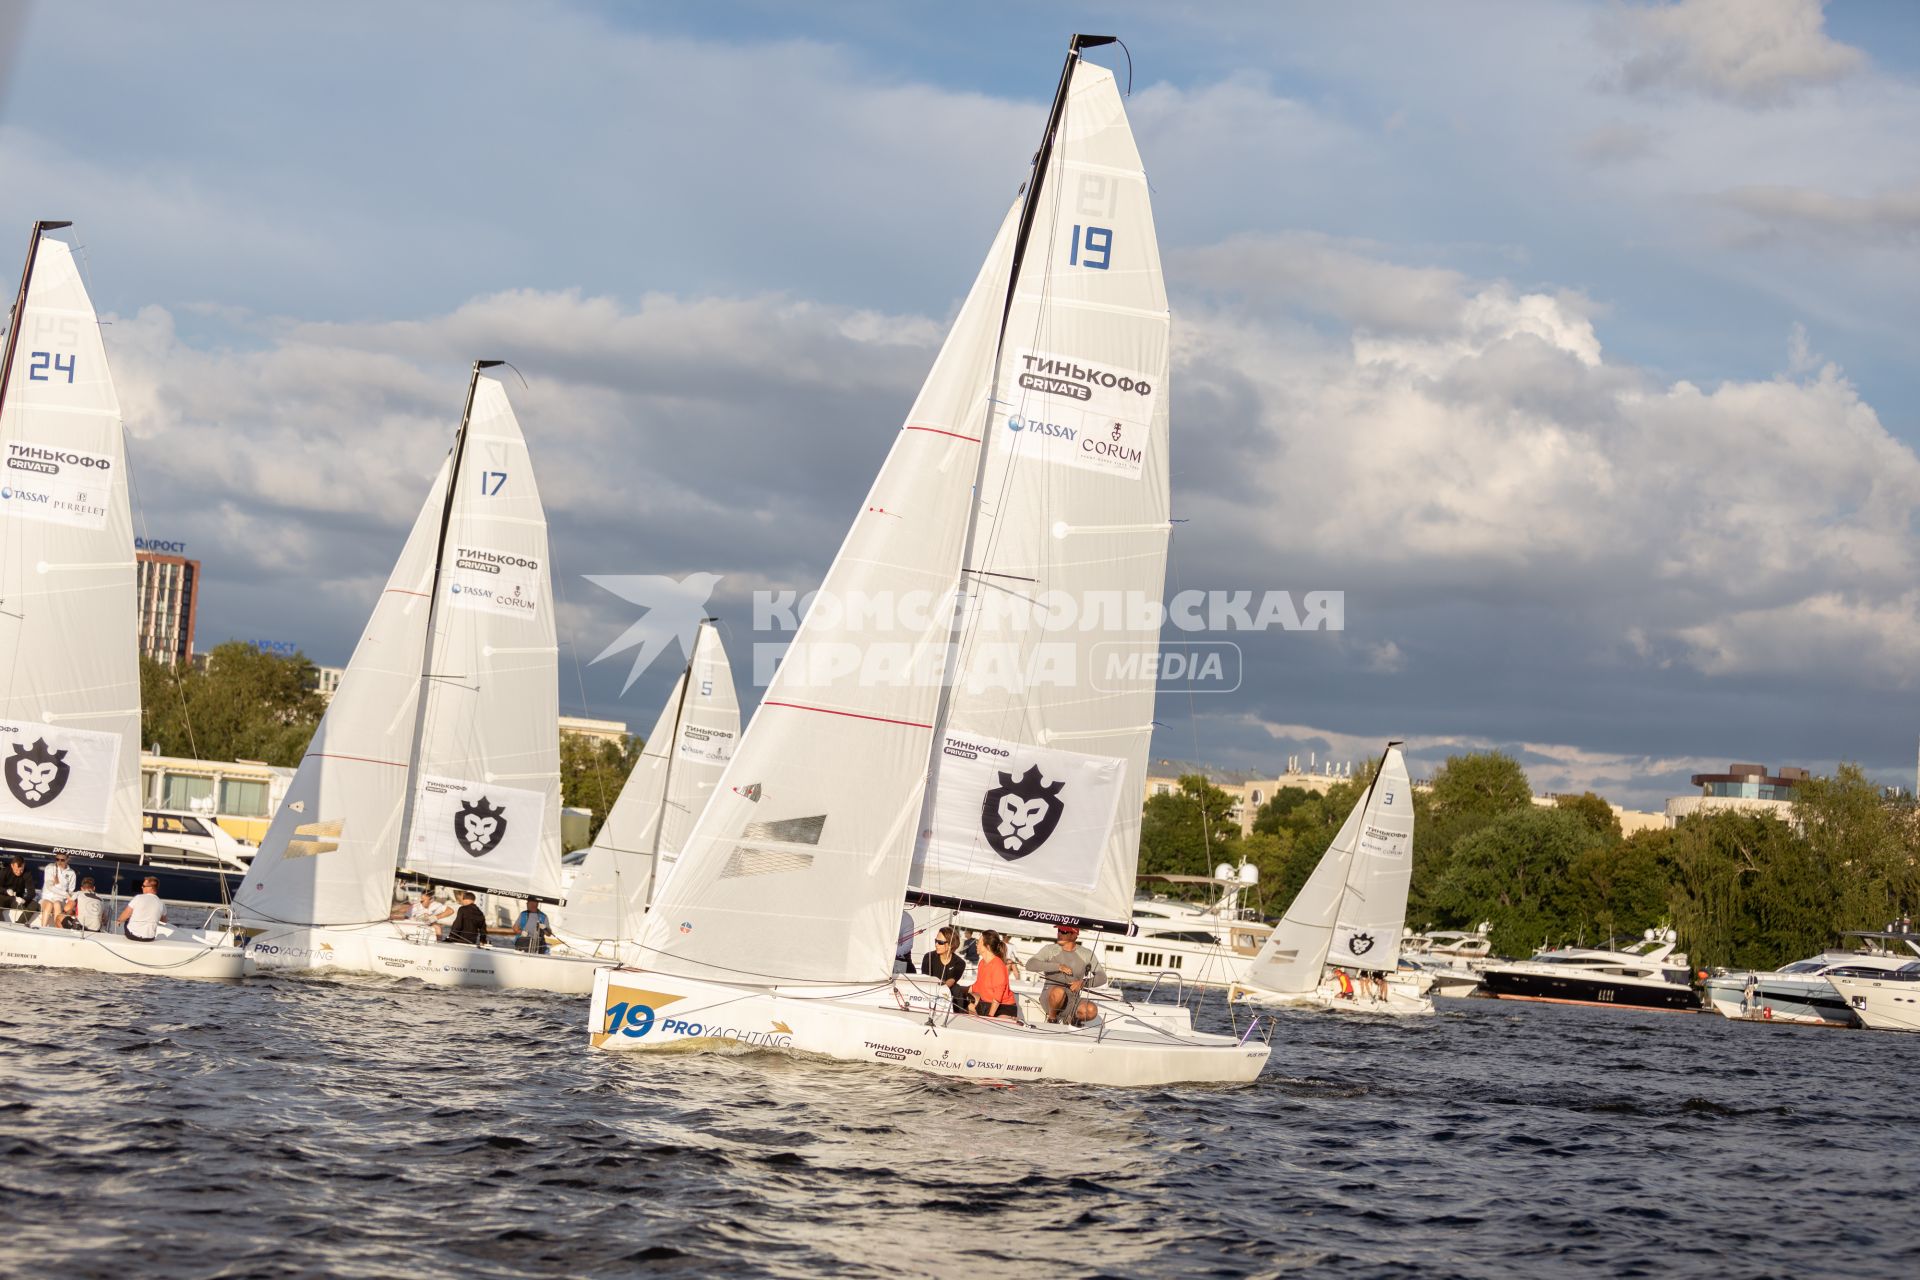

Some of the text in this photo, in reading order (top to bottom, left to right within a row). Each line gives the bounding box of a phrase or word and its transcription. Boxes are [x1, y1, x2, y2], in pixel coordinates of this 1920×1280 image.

[1070, 225, 1113, 270] 19
[30, 352, 75, 384] 24
[1022, 355, 1152, 396] ТИНЬКОФФ
[1024, 376, 1088, 399] PRIVATE
[1028, 420, 1078, 440] TASSAY
[9, 444, 111, 470] ТИНЬКОФФ
[1082, 438, 1142, 463] CORUM
[10, 459, 57, 473] PRIVATE
[482, 471, 507, 496] 17
[15, 490, 49, 503] TASSAY
[54, 500, 105, 516] PERRELET
[145, 539, 186, 552] КРОСТ
[458, 548, 538, 570] ТИНЬКОФФ
[458, 560, 498, 573] PRIVATE
[464, 586, 493, 598] TASSAY
[496, 596, 535, 610] CORUM
[701, 681, 713, 696] 5
[686, 724, 734, 739] ТИНЬКОФФ
[945, 748, 977, 759] PRIVATE
[946, 738, 1010, 758] ТИНЬКОФФ
[1384, 792, 1394, 805] 3
[53, 846, 104, 859] pro-yachting.ru
[1018, 908, 1080, 925] pro-yachting.ru
[606, 1001, 655, 1038] 19
[864, 1041, 922, 1057] ТИНЬКОФФ
[923, 1058, 961, 1070] CORUM
[977, 1061, 1004, 1070] TASSAY
